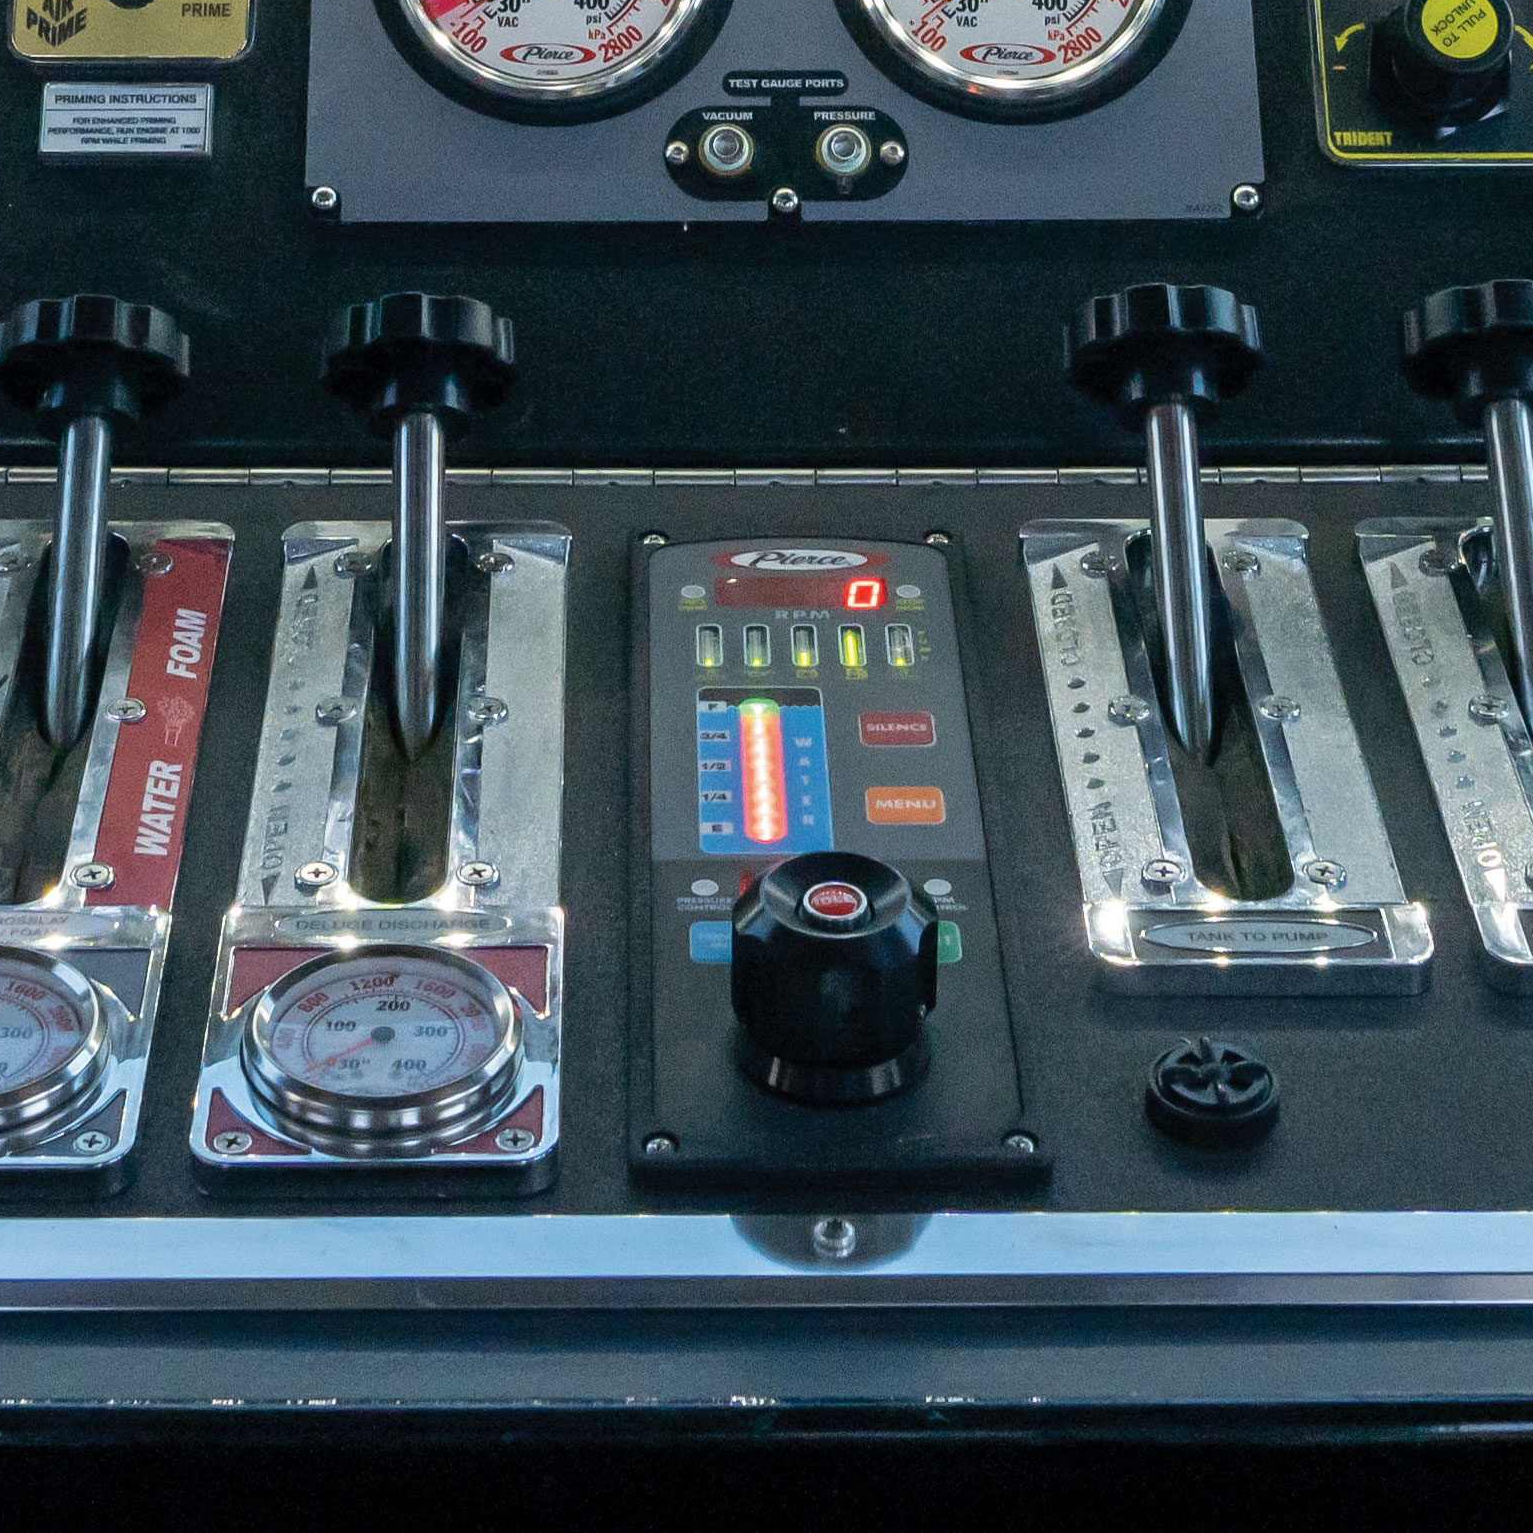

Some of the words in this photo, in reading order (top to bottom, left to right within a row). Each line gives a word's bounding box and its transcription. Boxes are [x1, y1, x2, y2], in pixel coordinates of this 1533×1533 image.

[182, 3, 231, 17] PRIME
[497, 17, 519, 27] VAC
[1457, 8, 1486, 32] PULL
[26, 6, 88, 47] PRIME
[598, 25, 643, 63] 2800
[1058, 26, 1102, 64] 2800
[1443, 32, 1460, 47] TO
[522, 46, 575, 62] Pierce
[983, 46, 1035, 62] Pierce
[729, 79, 758, 88] TEST
[761, 79, 802, 88] GAUGE
[805, 79, 844, 88] PORTS
[54, 94, 105, 105] PRIMING
[108, 94, 197, 105] INSTRUCTIONS
[702, 112, 753, 121] VACUUM
[813, 111, 876, 121] PRESSURE
[1334, 131, 1393, 146] TRIDENT
[750, 550, 848, 567] Pierce
[847, 581, 881, 608] 0
[775, 609, 830, 620] RPM
[166, 607, 207, 680] FOAM
[866, 722, 928, 732] SILENCE
[700, 732, 727, 740] 3/4
[701, 762, 727, 770] 1/2
[701, 793, 727, 801] 1/4
[133, 759, 183, 856] WATER
[875, 799, 936, 810] MENU
[295, 920, 374, 930] DELUGE
[378, 919, 491, 930] DISCHARGE
[1187, 933, 1232, 942] TANK
[1242, 933, 1266, 941] TO
[1272, 933, 1328, 942] PUMP
